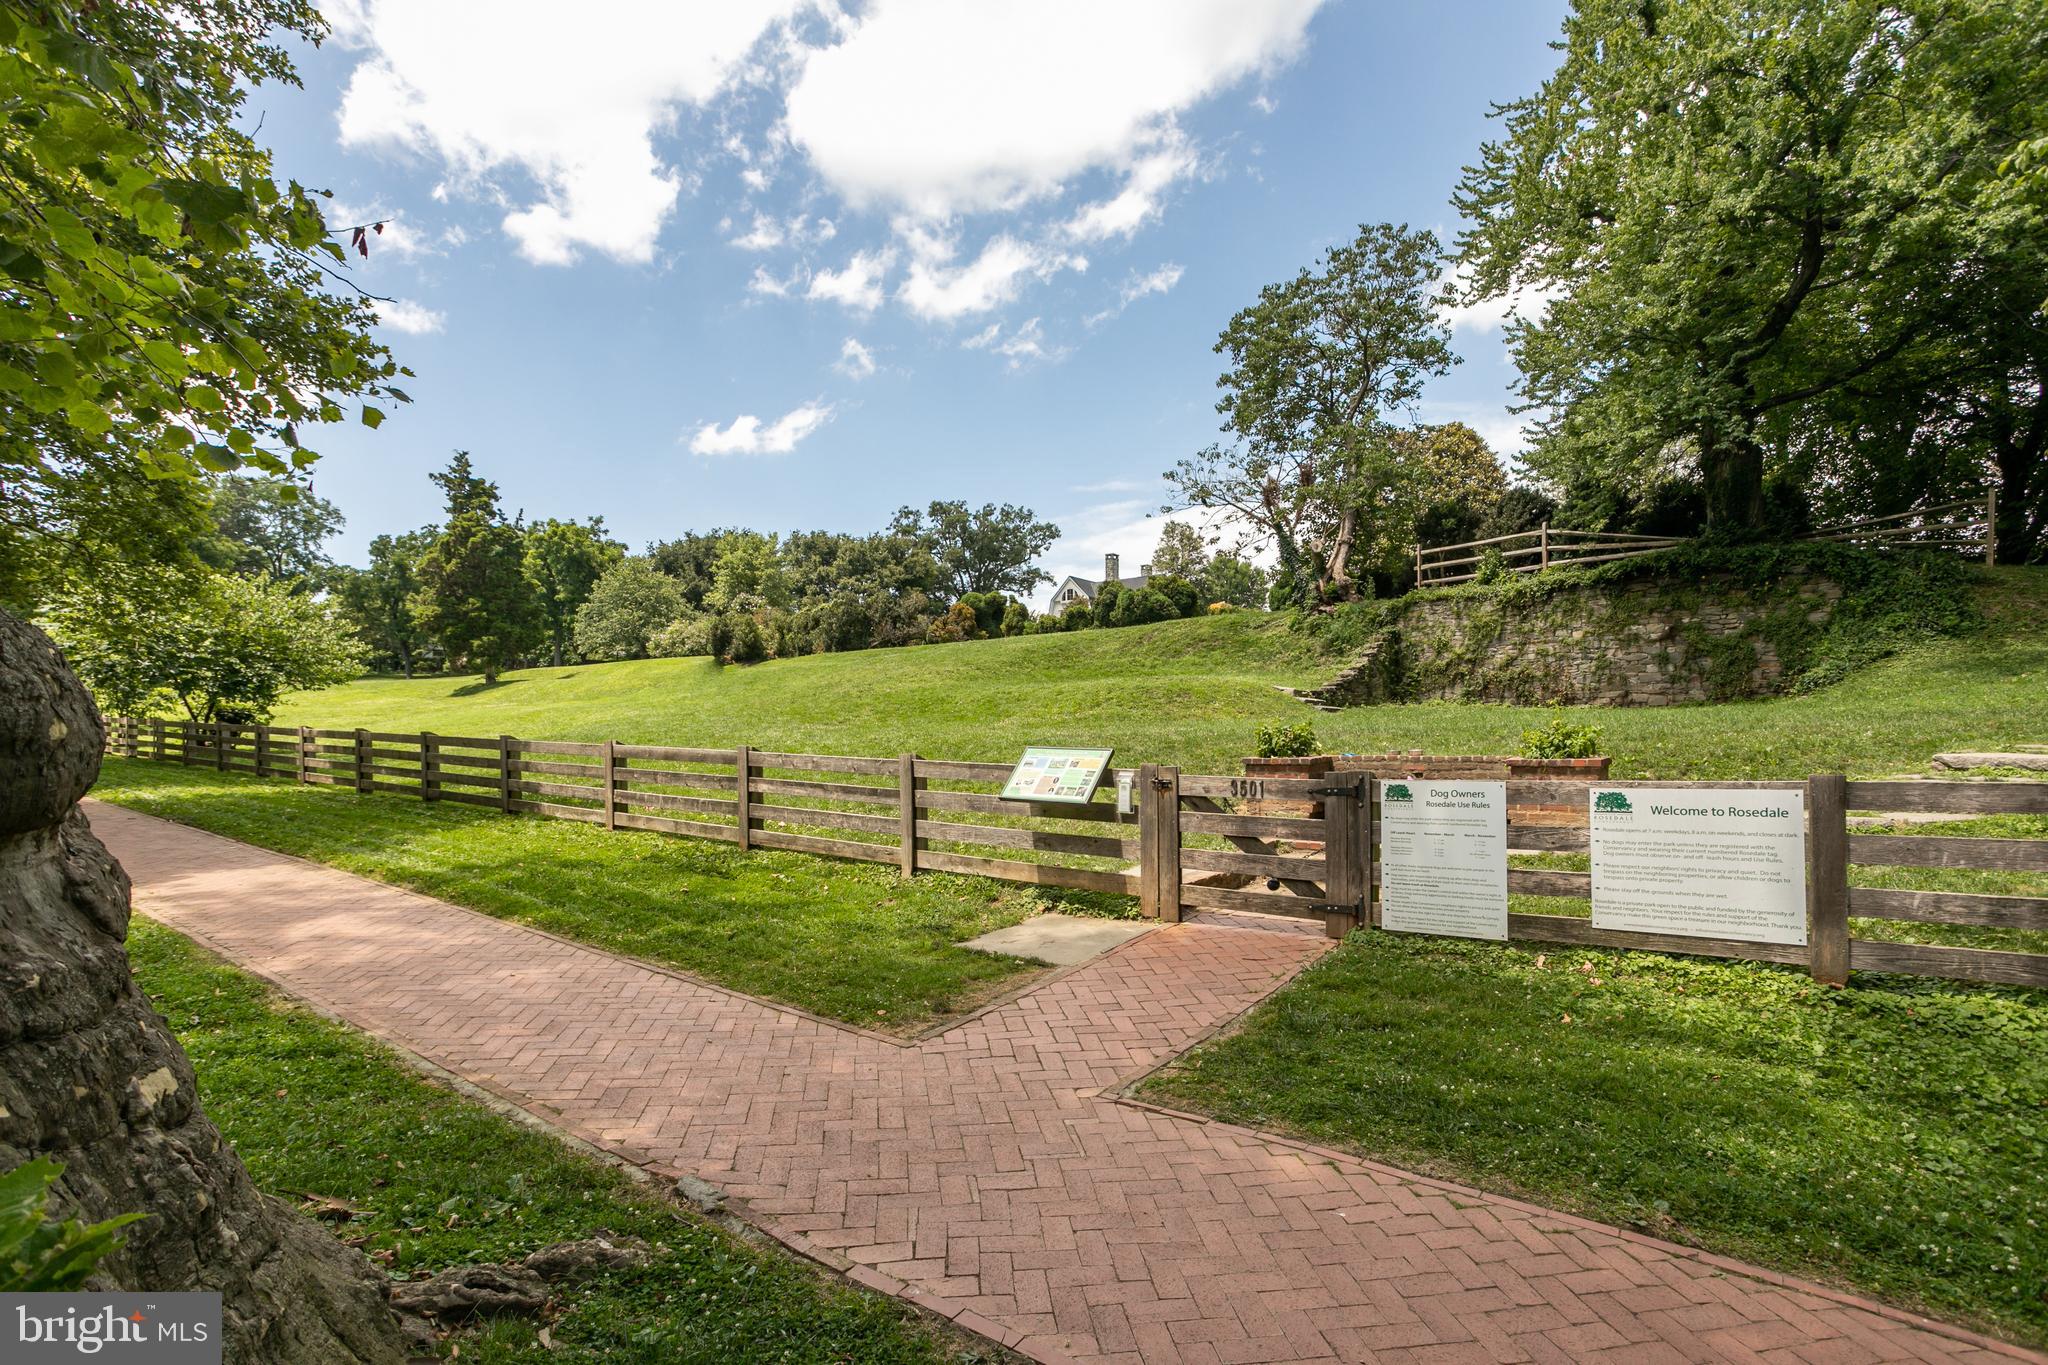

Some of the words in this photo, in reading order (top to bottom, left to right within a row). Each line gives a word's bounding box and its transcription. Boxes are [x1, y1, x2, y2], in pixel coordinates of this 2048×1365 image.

[1231, 779, 1264, 798] 3501
[1430, 789, 1448, 799] Dog
[1450, 790, 1486, 798] Owners
[1650, 806, 1708, 816] Welcome
[1712, 808, 1724, 816] to
[1728, 807, 1789, 818] Rosedale
